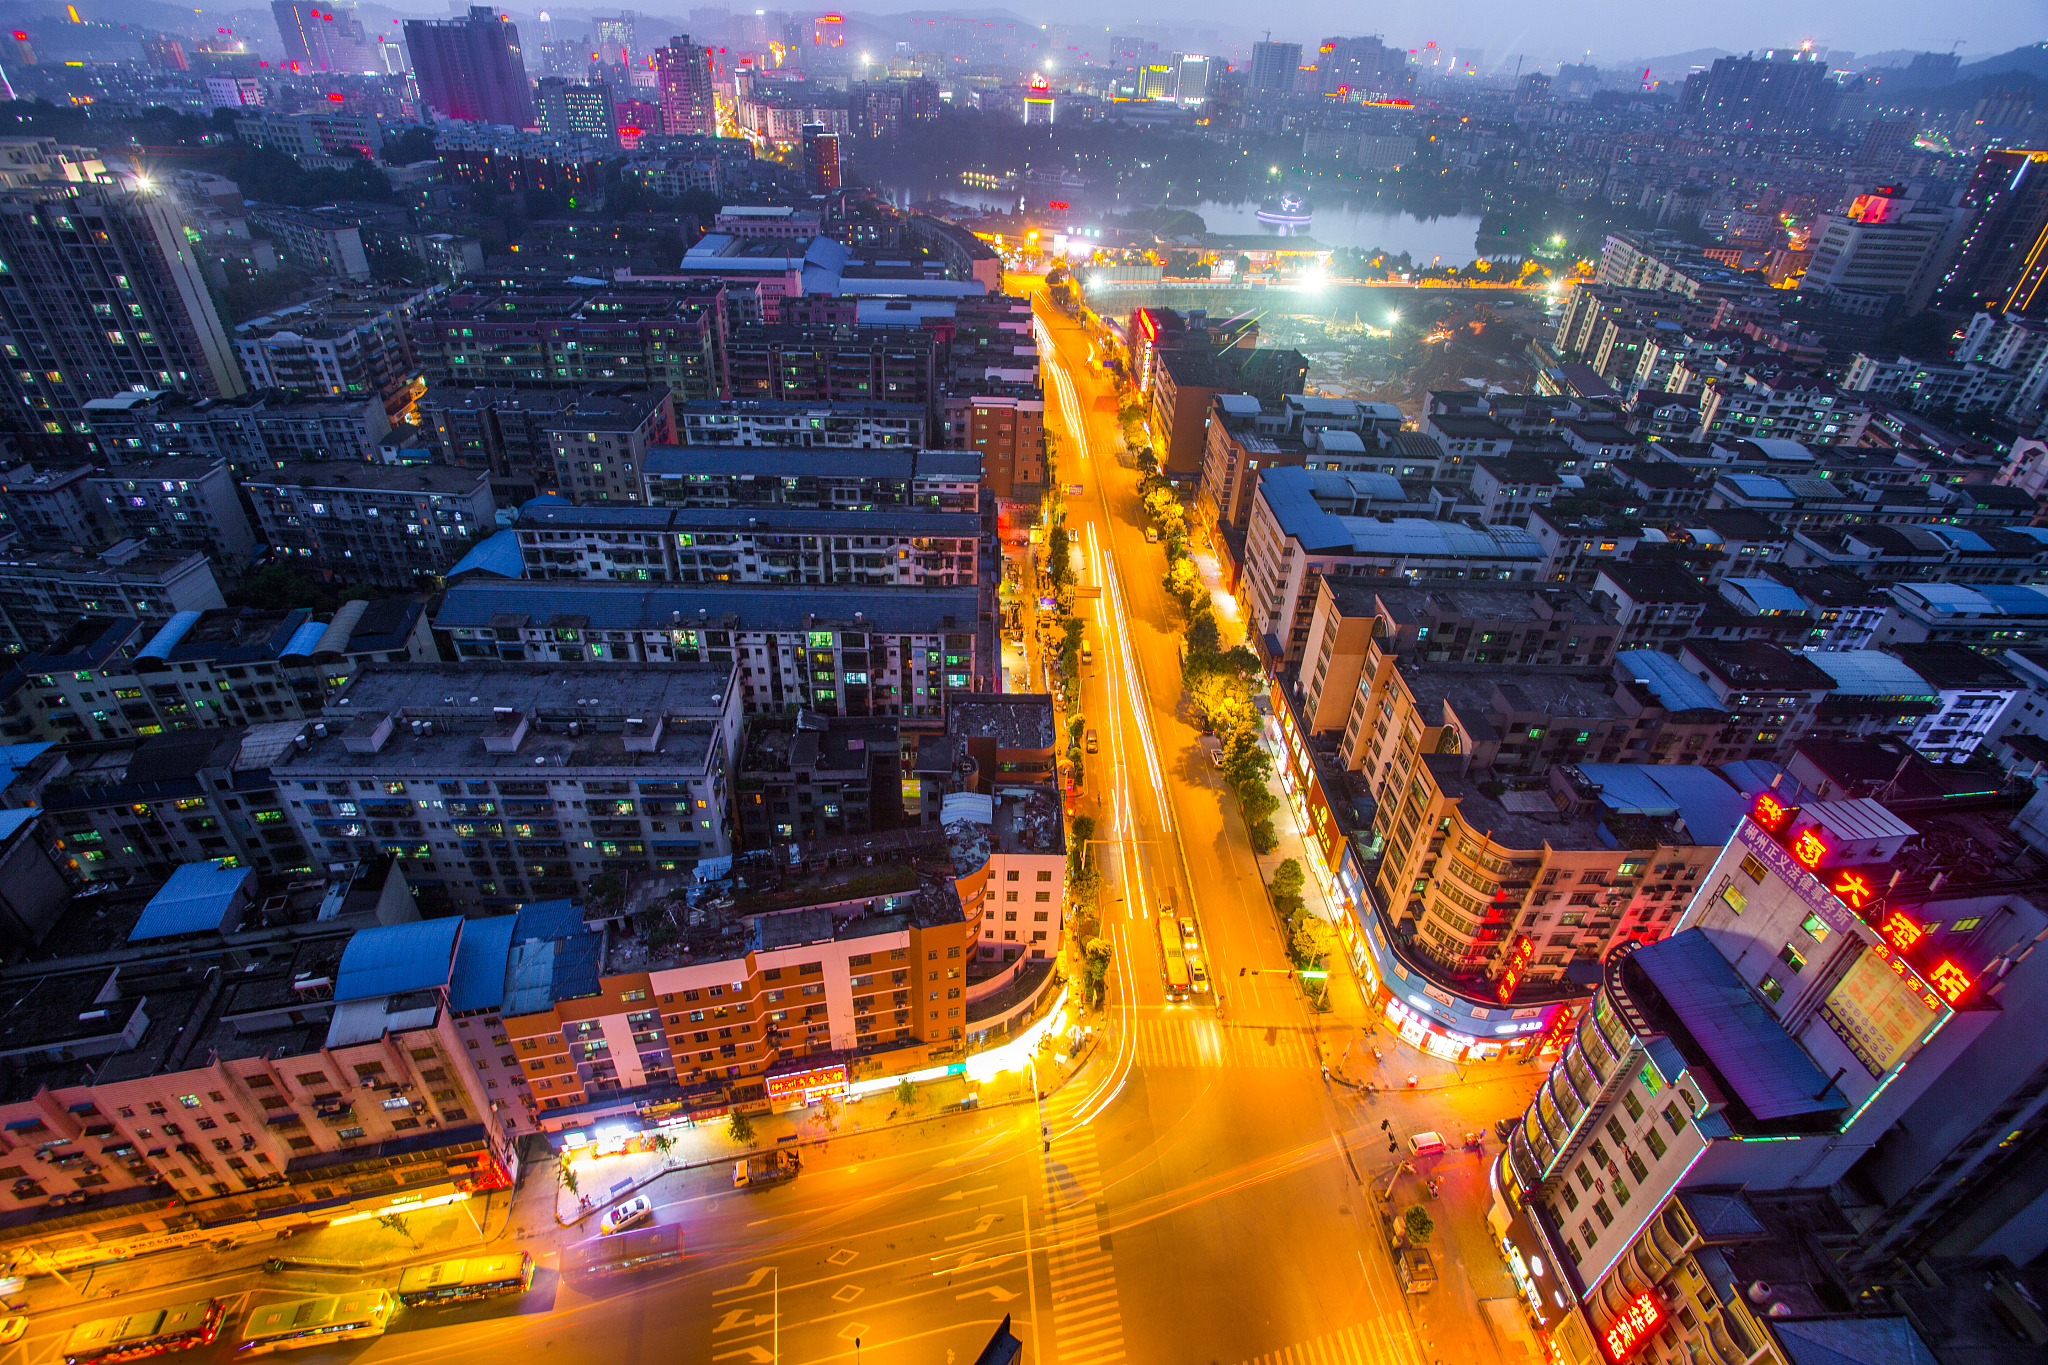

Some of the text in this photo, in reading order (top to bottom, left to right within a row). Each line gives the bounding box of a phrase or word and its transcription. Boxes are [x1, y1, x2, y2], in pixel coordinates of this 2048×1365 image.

[1743, 823, 1852, 927] 郴州正义法律事务所
[1855, 965, 1918, 1031] 快乐淘
[1873, 942, 1941, 1010] 商务客房
[1829, 997, 1888, 1063] 7586533
[1835, 990, 1895, 1055] 7586522
